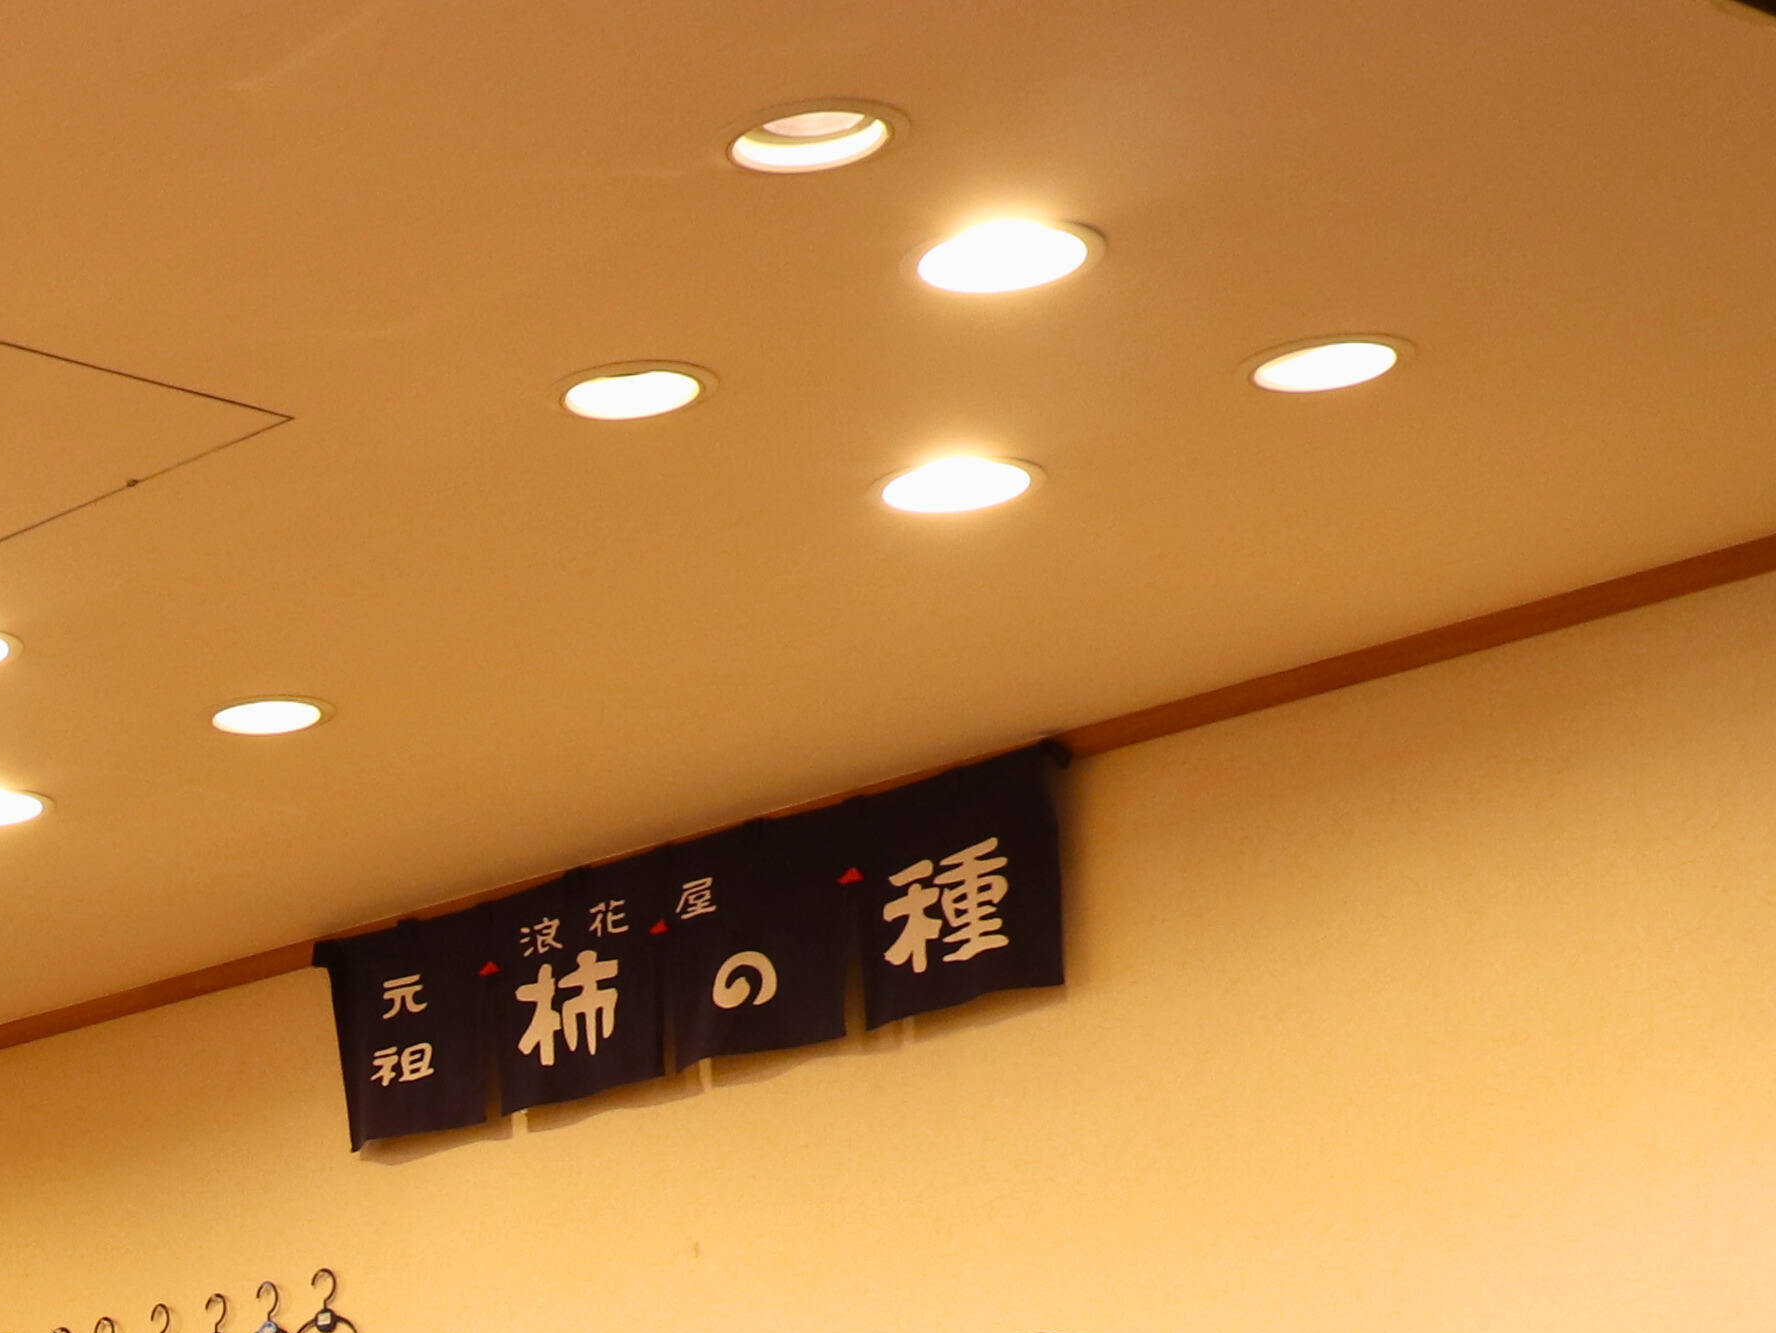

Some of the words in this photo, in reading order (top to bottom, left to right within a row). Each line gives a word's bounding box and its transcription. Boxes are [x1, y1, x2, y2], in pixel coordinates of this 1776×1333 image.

[514, 836, 1011, 1067] 柿の種
[519, 877, 717, 956] 浪花屋
[370, 973, 435, 1087] 元祖
